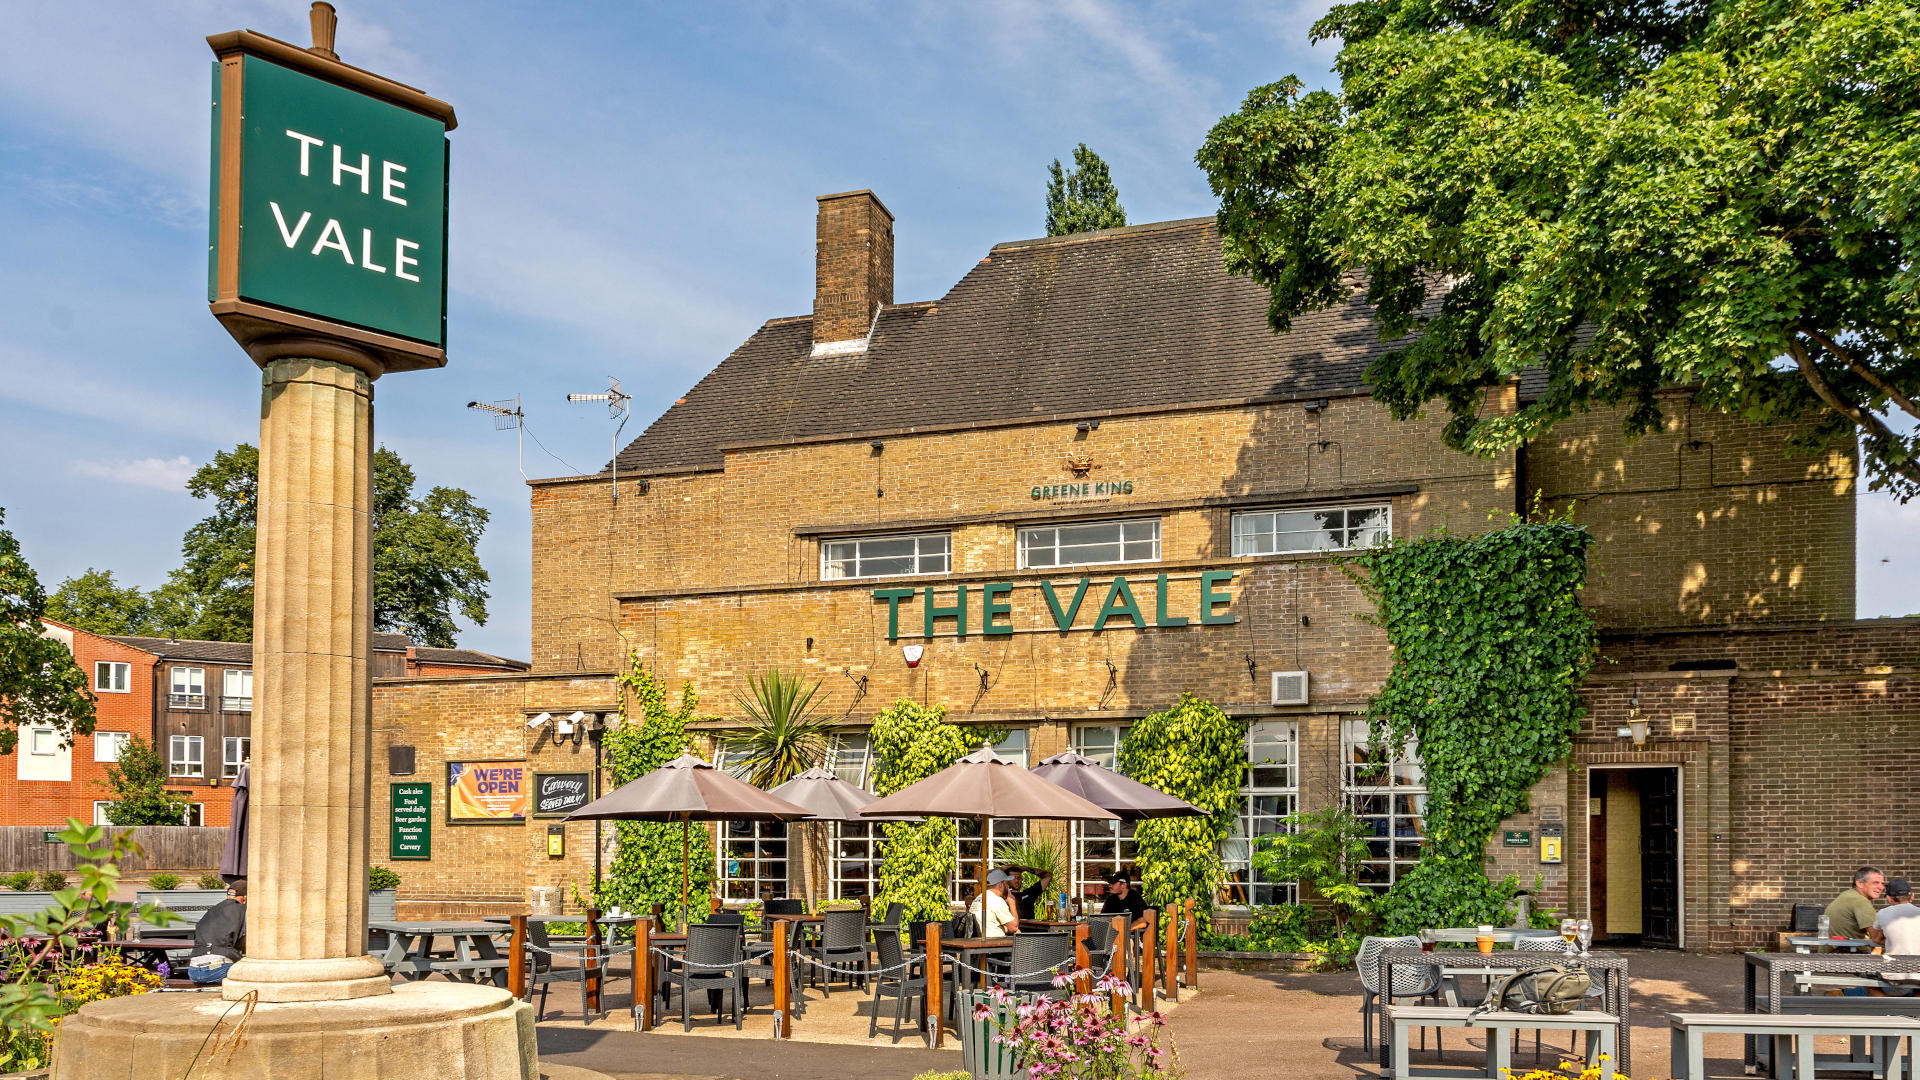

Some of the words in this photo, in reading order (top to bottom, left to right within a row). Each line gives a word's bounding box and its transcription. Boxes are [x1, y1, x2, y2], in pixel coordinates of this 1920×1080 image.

[286, 129, 407, 206] THE
[269, 201, 420, 282] VALE
[1031, 483, 1089, 498] GREENE
[1095, 480, 1133, 494] KING
[873, 582, 1014, 639] THE
[1041, 570, 1236, 632] VALE
[478, 781, 519, 793] OPEN
[542, 776, 583, 795] Carvery
[540, 798, 563, 810] SERVED
[563, 793, 586, 806] DAILY!
